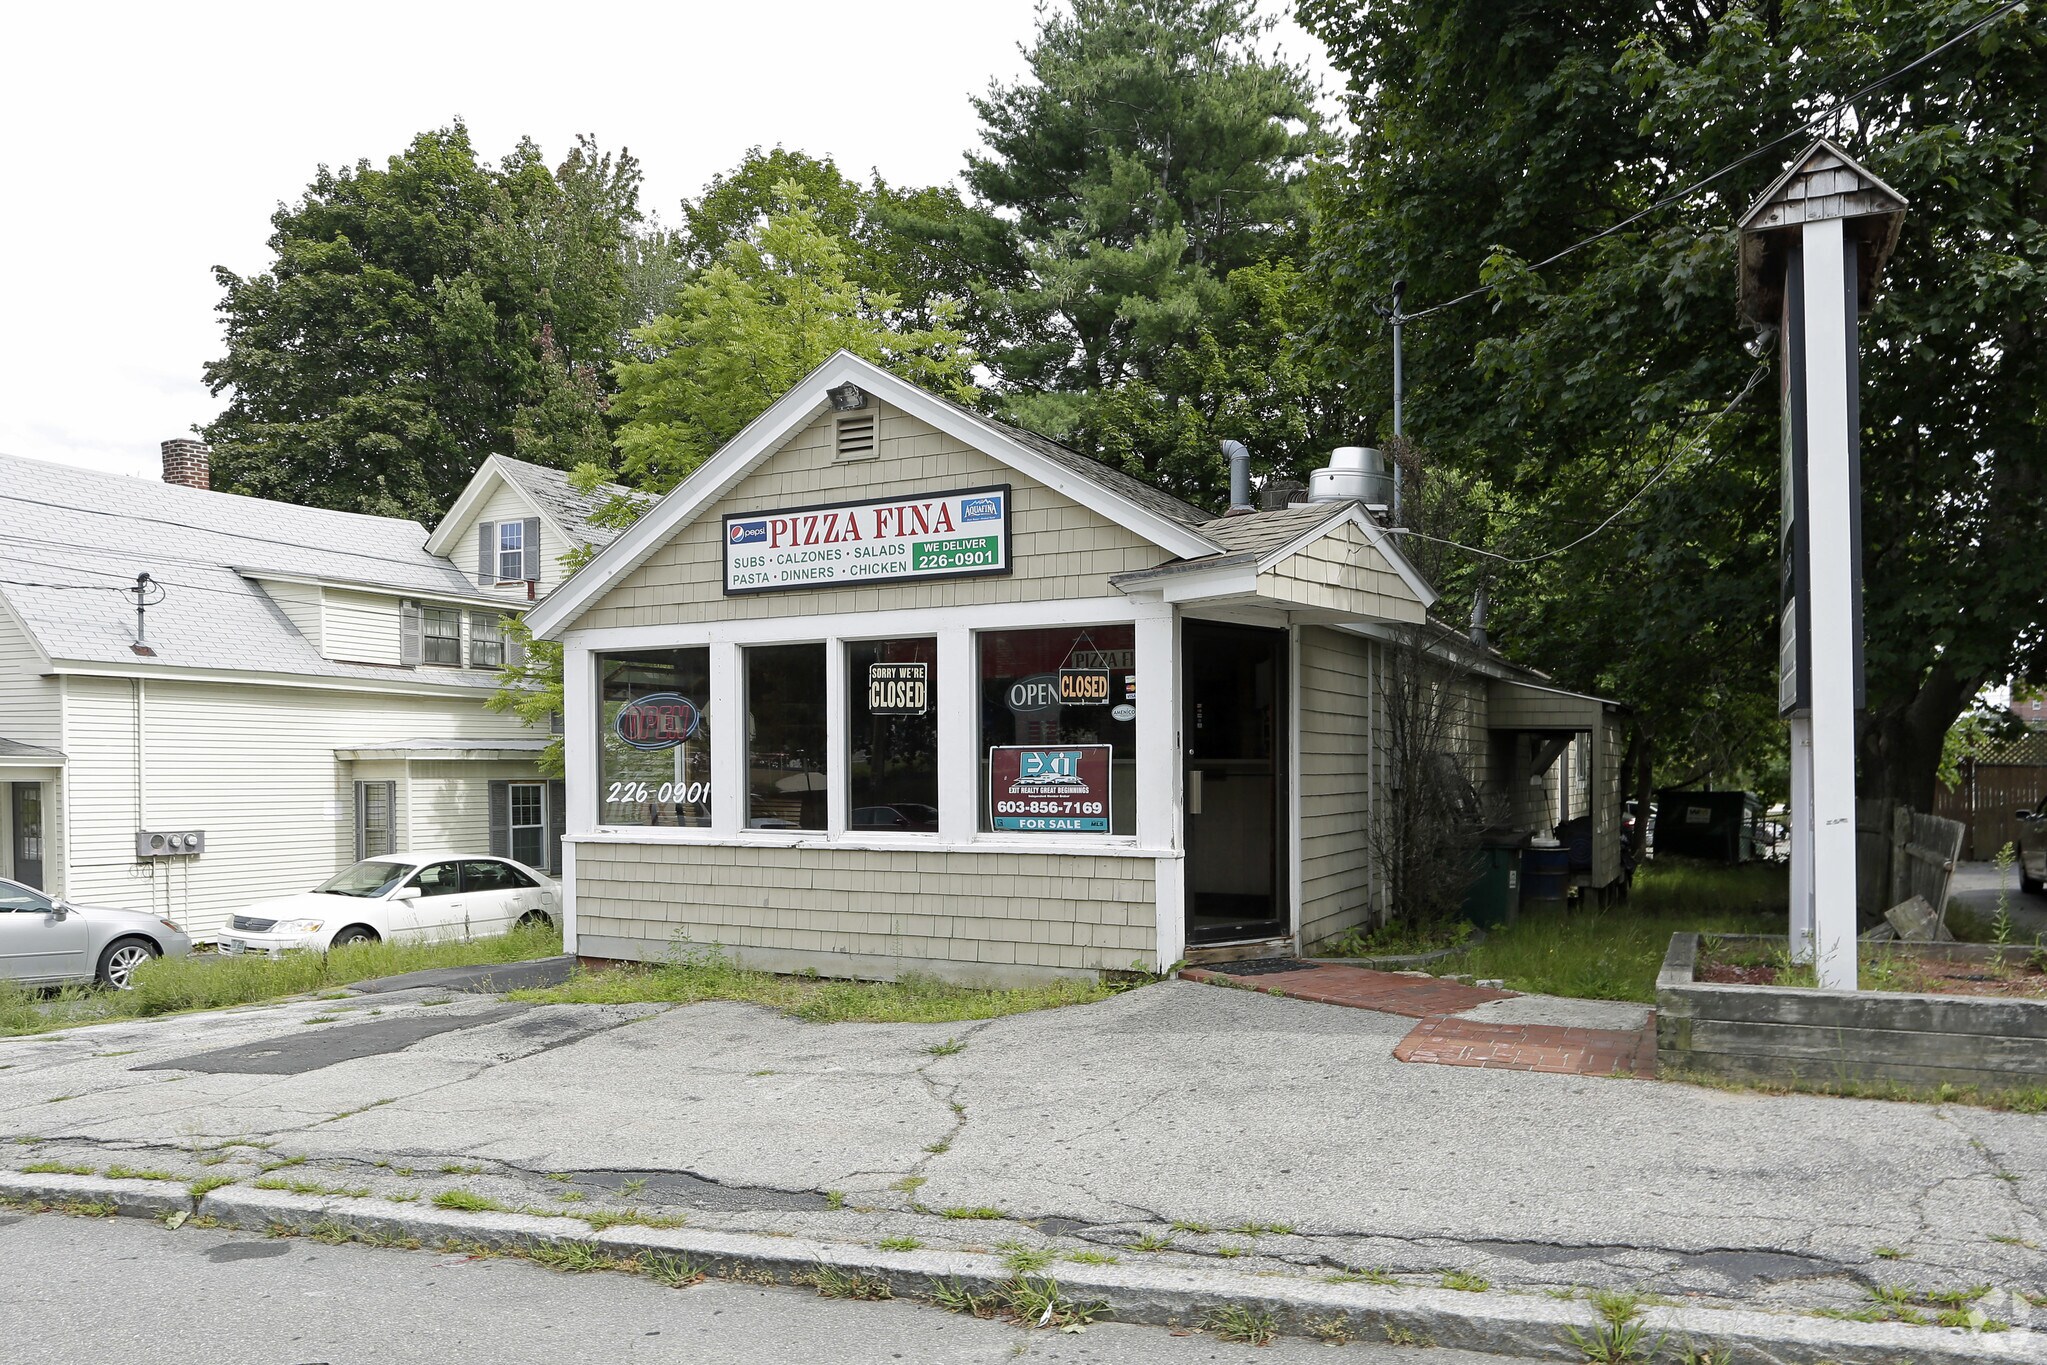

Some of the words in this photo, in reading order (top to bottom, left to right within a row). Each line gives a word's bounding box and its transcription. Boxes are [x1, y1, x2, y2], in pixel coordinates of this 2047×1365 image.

[964, 503, 998, 517] AQUAFINA
[745, 526, 765, 538] pepsi
[769, 511, 862, 549] PIZZA
[873, 502, 956, 539] FINA
[923, 542, 940, 553] WE
[943, 538, 986, 551] DELIVER
[734, 556, 766, 569] SUBS
[776, 549, 842, 565] CALZONES
[854, 543, 905, 558] SALADS
[918, 550, 992, 569] 226-0901
[733, 572, 770, 585] PASTA
[781, 567, 834, 581] DINNERS
[850, 561, 907, 576] CHICKEN
[1075, 652, 1117, 668] PIZZA
[872, 667, 896, 679] SORRY
[899, 667, 924, 679] WE'RE
[871, 681, 924, 708] CLOSED
[1010, 683, 1058, 706] OPEN
[1061, 675, 1107, 698] CLOSED
[624, 705, 690, 740] OPEN
[605, 781, 710, 804] 226-0901
[1008, 786, 1020, 794] EXIT
[1020, 786, 1039, 794] REALTY
[1040, 786, 1056, 794] GREAT
[1057, 786, 1090, 794] BEGINNINGS
[997, 801, 1103, 814] 603-856-7169
[1019, 819, 1045, 829] FOR
[1049, 819, 1081, 829] SALE
